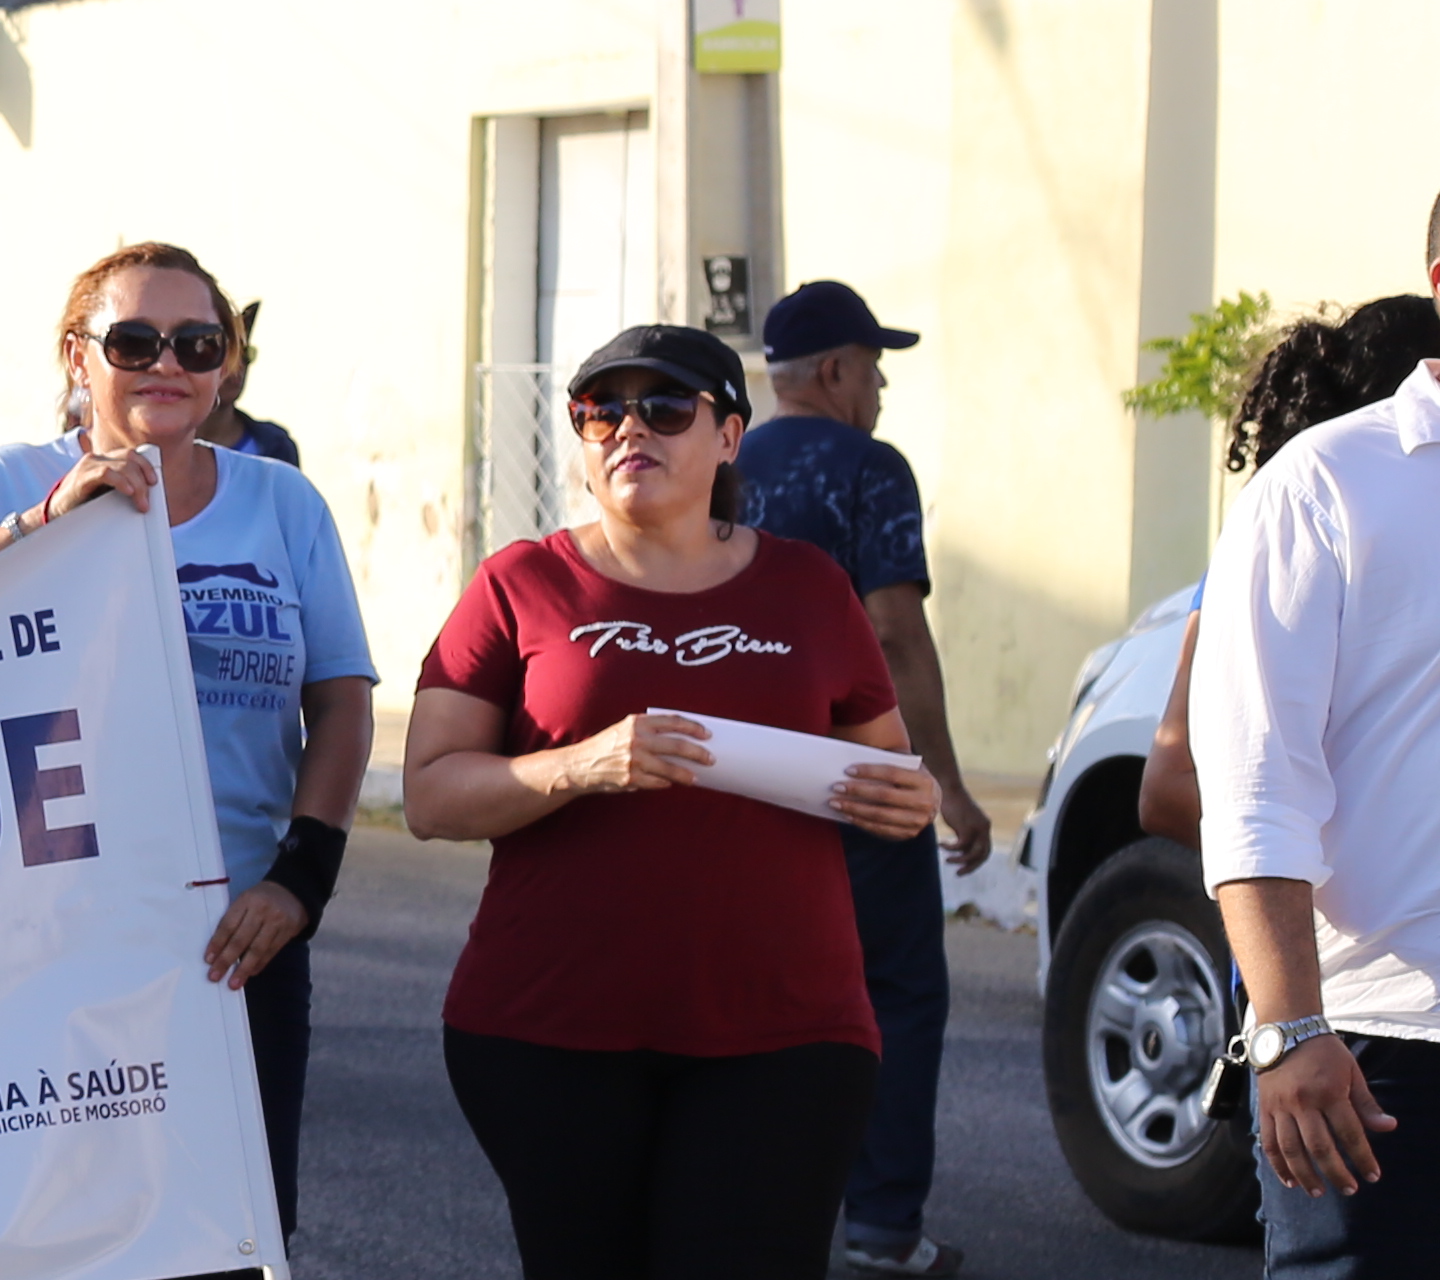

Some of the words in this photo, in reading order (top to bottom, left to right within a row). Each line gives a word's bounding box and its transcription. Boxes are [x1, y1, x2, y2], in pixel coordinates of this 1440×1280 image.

[179, 587, 283, 607] OVEMBRO
[8, 608, 62, 658] DE
[675, 624, 792, 667] Bien
[218, 648, 296, 687] #DRIBLE
[37, 1068, 61, 1106] À
[67, 1058, 169, 1102] SAÚDE
[60, 1106, 84, 1125] DE
[85, 1091, 167, 1121] MOSSORÓ
